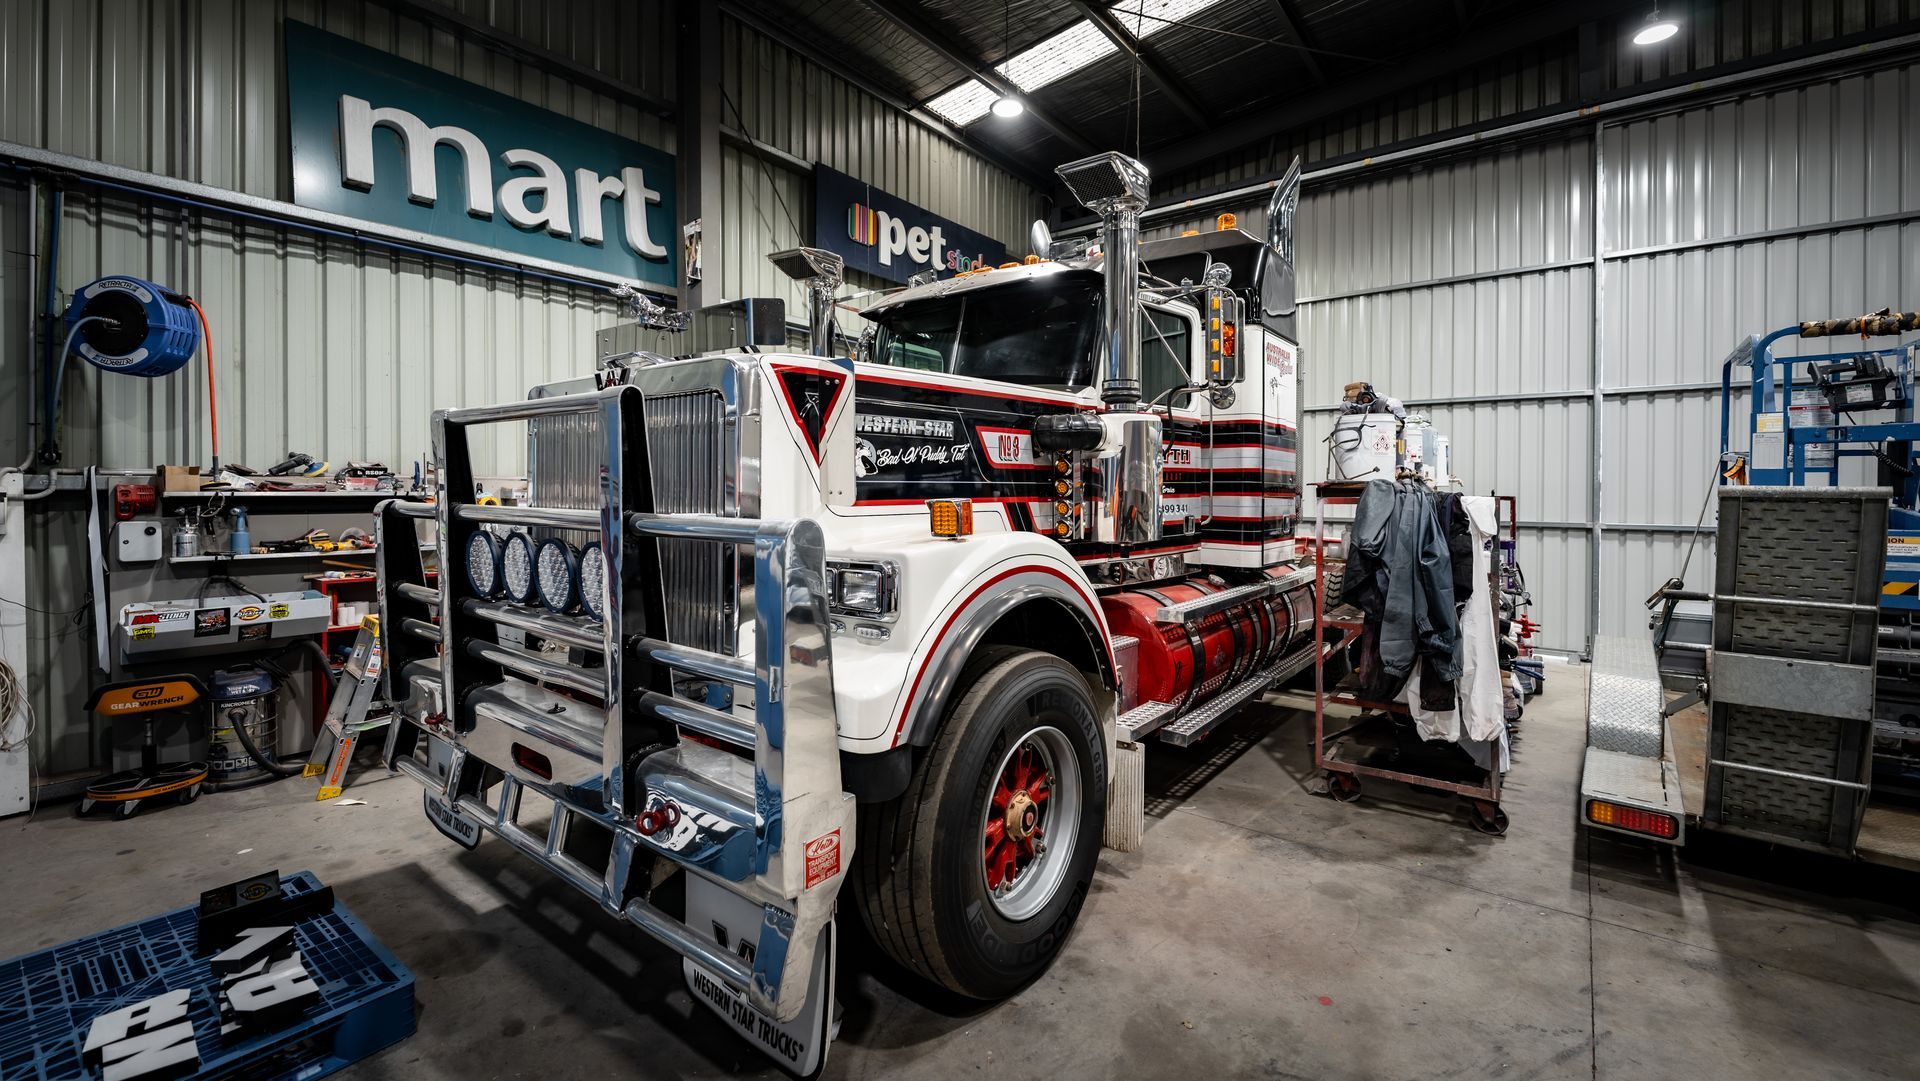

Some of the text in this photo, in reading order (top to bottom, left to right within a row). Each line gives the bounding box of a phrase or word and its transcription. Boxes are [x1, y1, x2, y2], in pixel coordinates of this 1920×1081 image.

[339, 94, 667, 260] mart
[877, 210, 946, 271] pet
[110, 696, 184, 711] GEARWRENCH
[693, 968, 731, 1016] WESTERN
[731, 1000, 754, 1035] STAR
